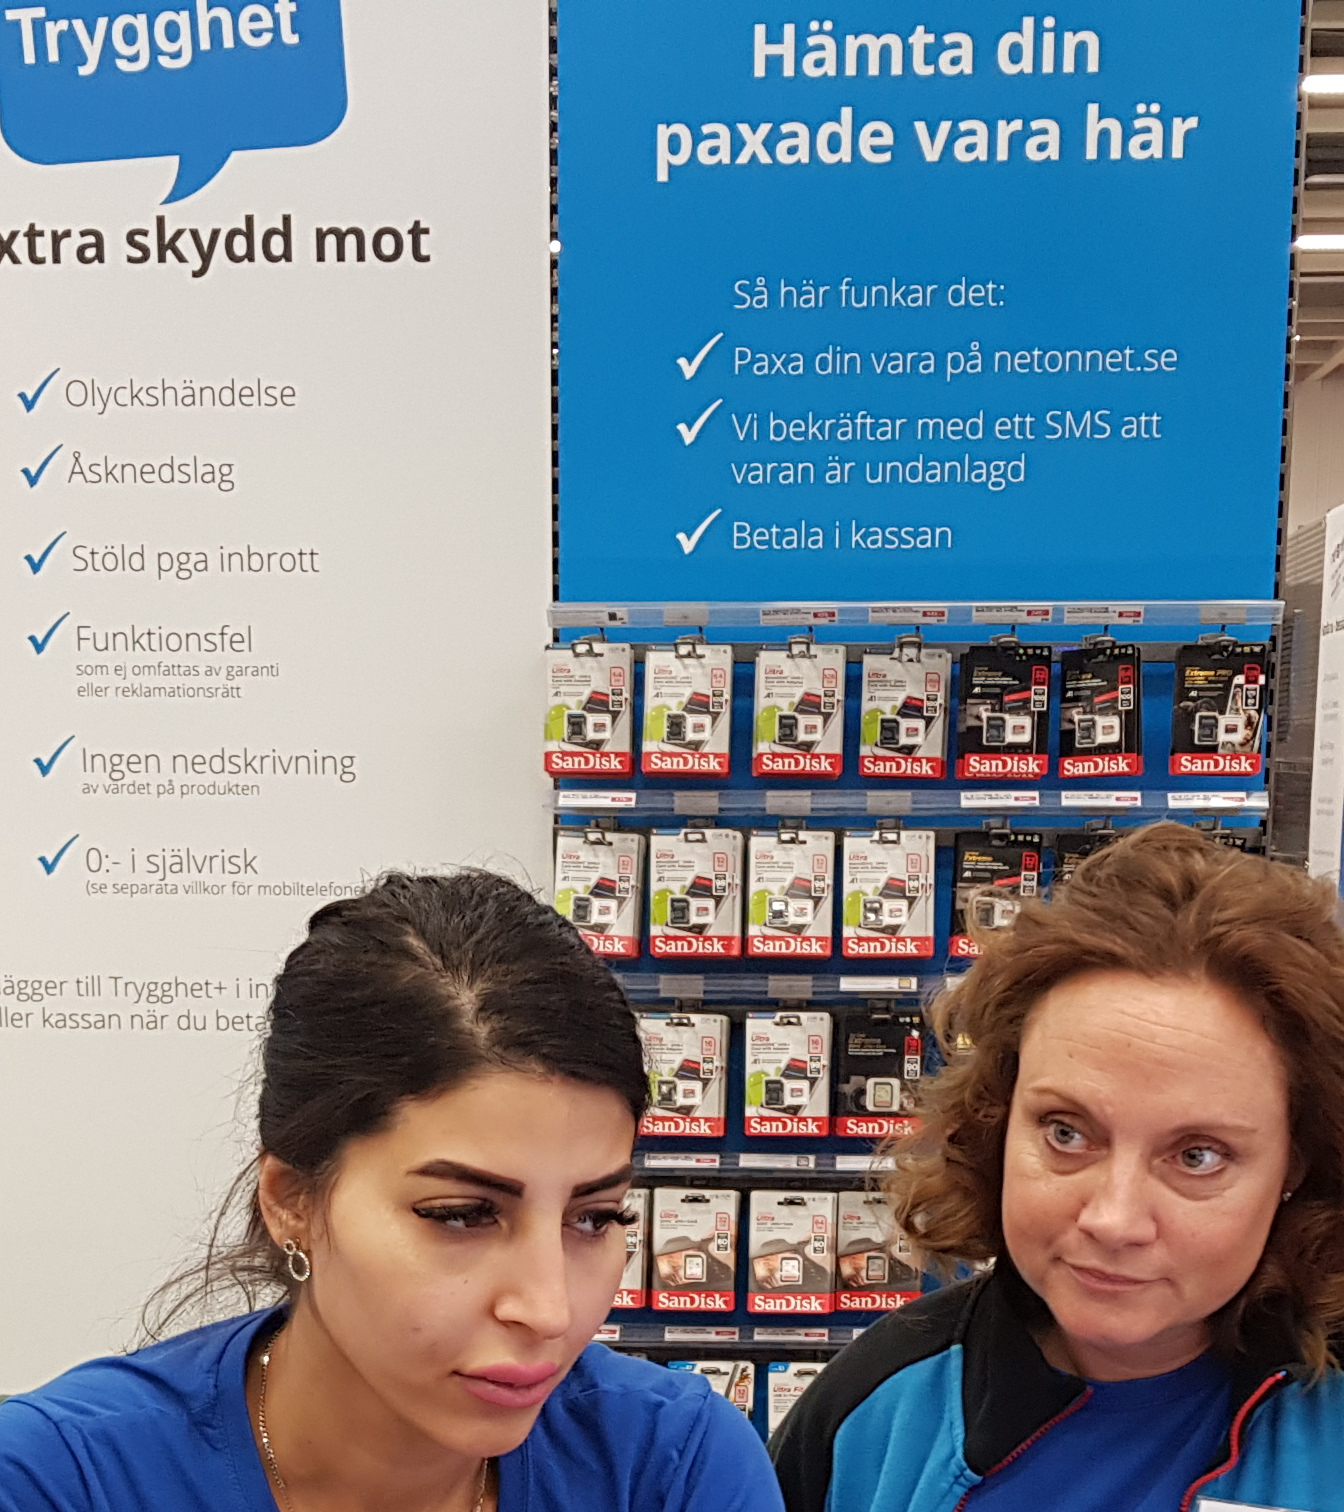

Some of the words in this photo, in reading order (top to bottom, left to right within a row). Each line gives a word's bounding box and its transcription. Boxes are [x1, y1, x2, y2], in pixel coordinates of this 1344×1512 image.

[4, 0, 300, 76] Trygghet
[753, 19, 973, 78] Hämta
[997, 15, 1100, 75] din
[656, 106, 894, 183] paxade
[913, 118, 1060, 163] vara
[1085, 102, 1199, 160] här
[125, 213, 293, 279] skydd
[315, 219, 431, 263] mot
[733, 276, 768, 309] Så
[780, 278, 831, 309] här
[839, 277, 939, 308] funkar
[947, 276, 1005, 307] det:
[734, 347, 805, 376] Paxa
[815, 344, 861, 375] din
[870, 351, 935, 375] vara
[946, 341, 983, 383] på
[994, 345, 1179, 373] netonnet.se
[65, 377, 296, 416] Olyckshändelse
[731, 413, 758, 441] Vi
[769, 410, 908, 442] bekräftar
[917, 409, 985, 440] med
[994, 413, 1036, 440] ett
[1045, 409, 1111, 439] SMS
[1121, 411, 1162, 439] att
[67, 450, 235, 493] Åsknedslag
[731, 462, 815, 485] varan
[825, 455, 856, 484] är
[866, 452, 1025, 491] undanlagd
[733, 519, 824, 550] Betala
[835, 520, 841, 549] i
[851, 519, 952, 549] kassan
[72, 543, 145, 573] Stöld
[157, 551, 209, 581] pga
[219, 544, 320, 573] inbrott
[76, 624, 252, 653] Funktionsfel
[75, 664, 110, 677] som
[113, 664, 127, 681] ej
[131, 660, 200, 677] omfattas
[204, 665, 222, 677] av
[225, 664, 280, 682] garanti
[76, 682, 110, 698] eller
[114, 682, 242, 699] reklamationsrätt
[82, 747, 161, 783] Ingen
[172, 747, 357, 784] nedskrivning
[552, 752, 623, 770] SanDisk
[762, 754, 833, 772] SanDisk
[968, 756, 1041, 773] SanDisk
[1180, 755, 1254, 772] SanDisk
[81, 782, 100, 795] av
[156, 778, 175, 799] på
[179, 780, 260, 799] produkten
[85, 847, 121, 874] 0:-
[131, 847, 136, 874] i
[145, 847, 259, 882] självrisk
[85, 879, 108, 897] (se
[112, 882, 179, 899] separata
[182, 880, 227, 896] villkor
[230, 880, 254, 896] för
[655, 936, 724, 954] SanDisk
[847, 938, 918, 955] SanDisk
[75, 974, 102, 997] till
[108, 975, 228, 1005] Trygghet+
[235, 977, 240, 999] i
[41, 1006, 122, 1030] kassan
[130, 1013, 170, 1031] när
[176, 1008, 207, 1032] du
[749, 1117, 822, 1135] SanDisk
[658, 1294, 725, 1308] SanDisk
